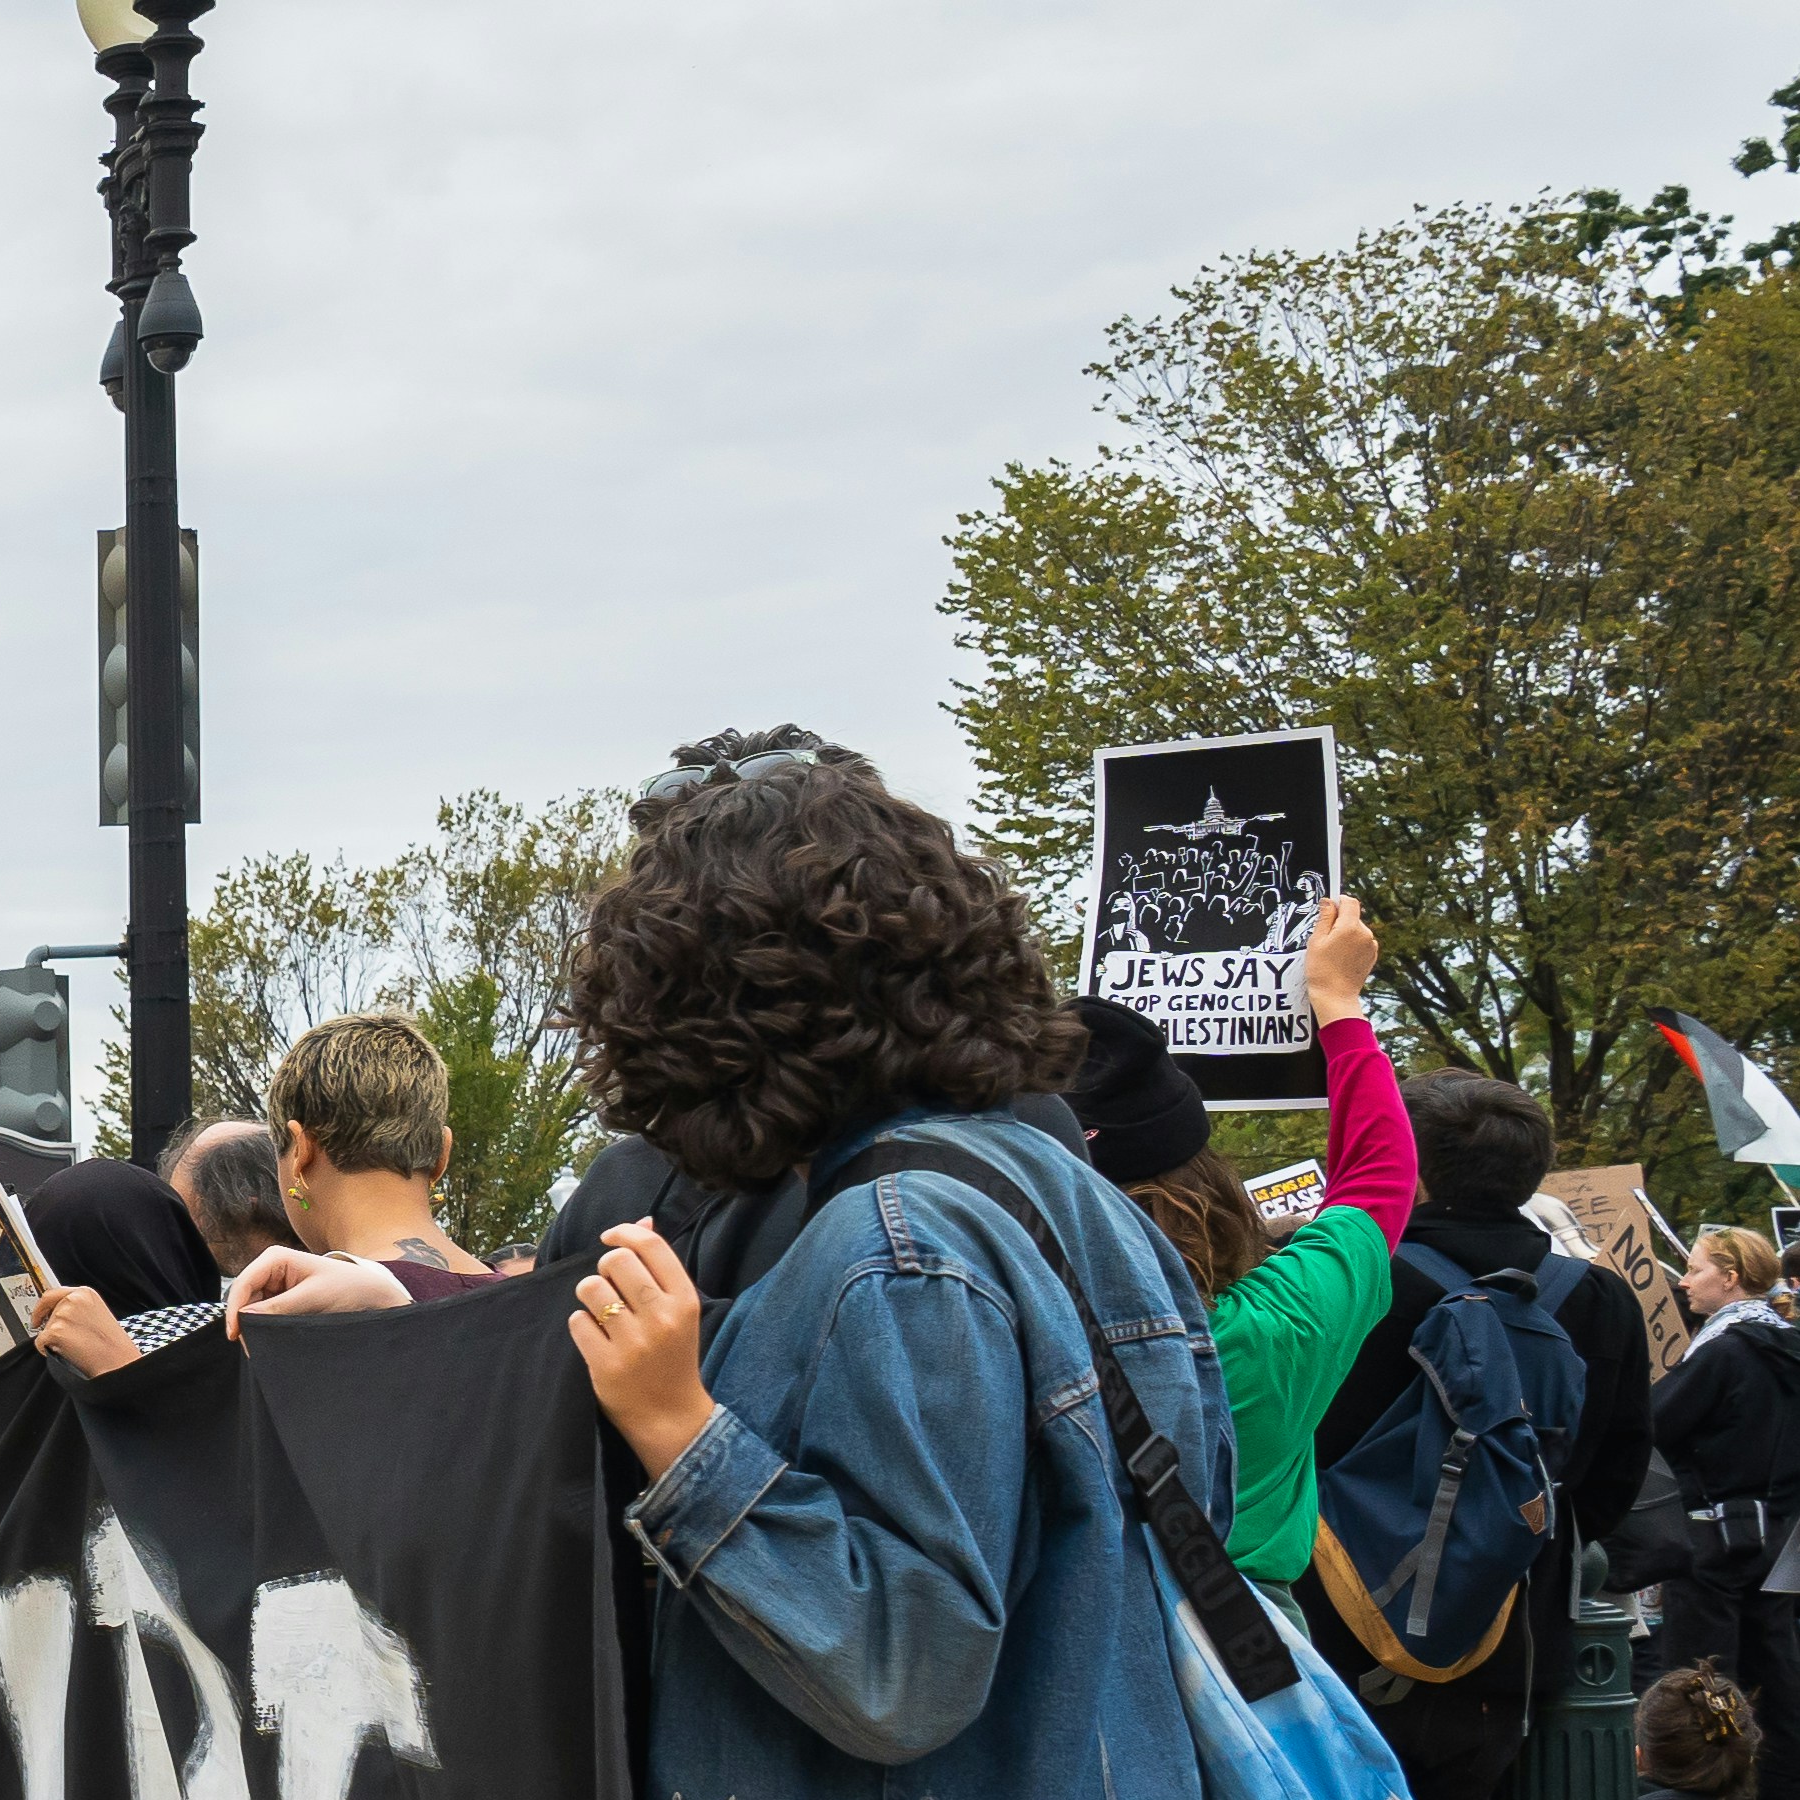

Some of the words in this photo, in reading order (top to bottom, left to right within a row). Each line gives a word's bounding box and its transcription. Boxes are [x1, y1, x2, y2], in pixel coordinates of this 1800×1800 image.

[1109, 957, 1206, 992] JEWS
[1213, 957, 1296, 991] SAY
[1167, 993, 1293, 1013] GENOCIDE
[1158, 1013, 1310, 1047] ALESTINIANS
[1259, 1184, 1325, 1220] CEASE
[1612, 1223, 1655, 1292] NO
[1646, 1296, 1668, 1343] to
